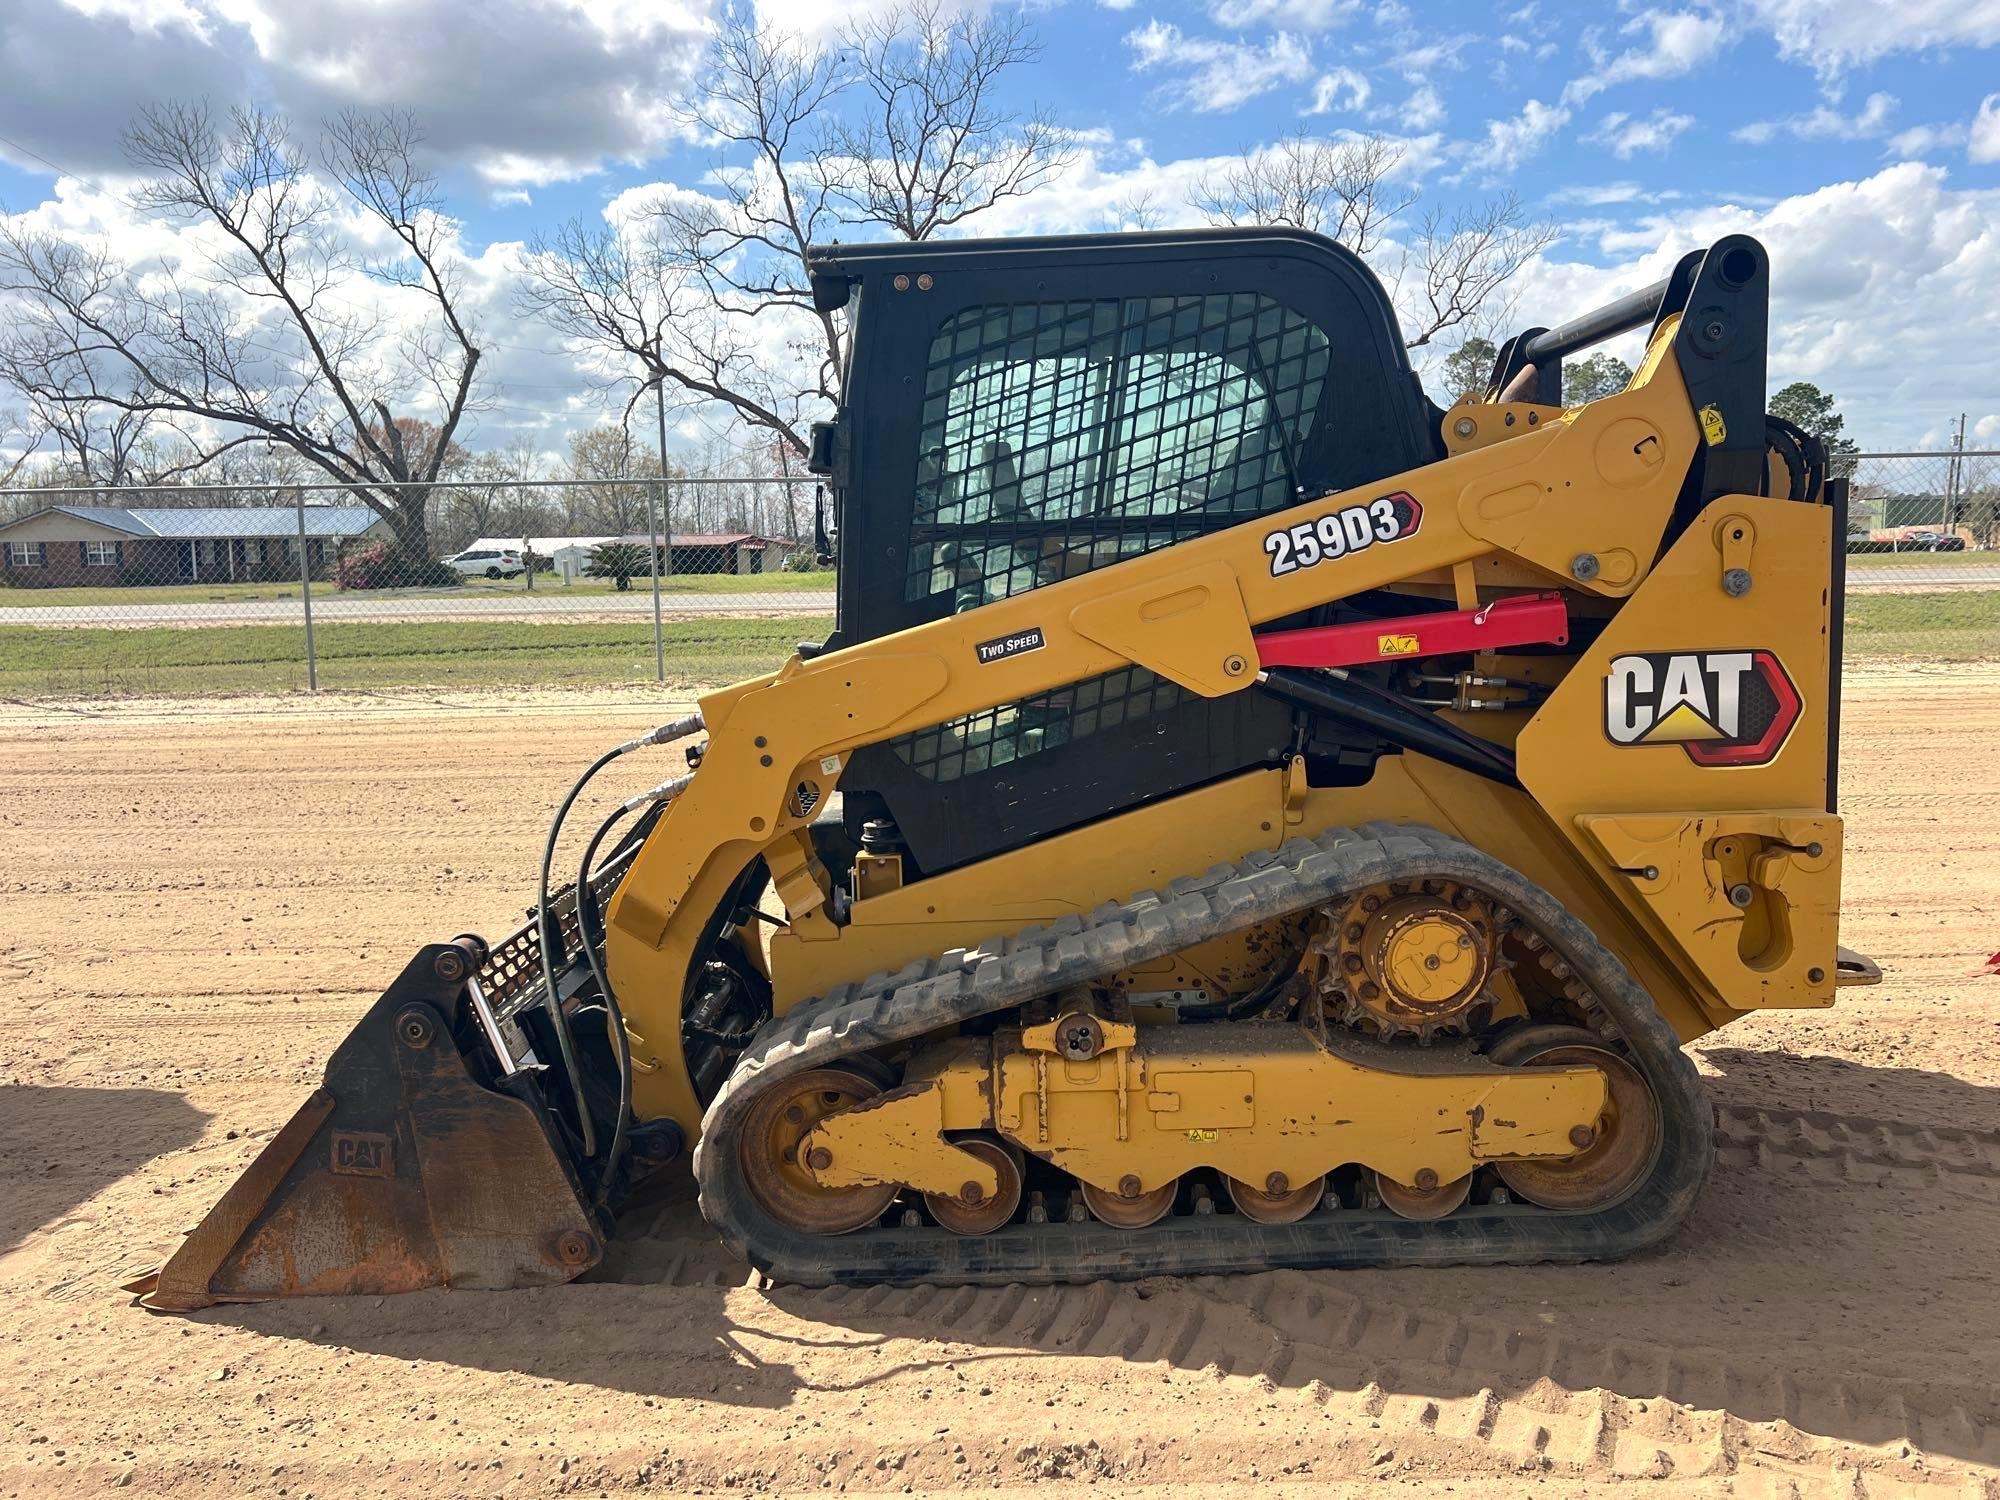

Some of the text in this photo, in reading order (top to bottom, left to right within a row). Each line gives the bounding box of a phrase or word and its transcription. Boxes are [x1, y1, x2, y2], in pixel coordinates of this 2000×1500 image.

[1265, 499, 1400, 575] 259D3
[1607, 653, 1753, 743] CAT
[338, 1138, 386, 1169] CAT
